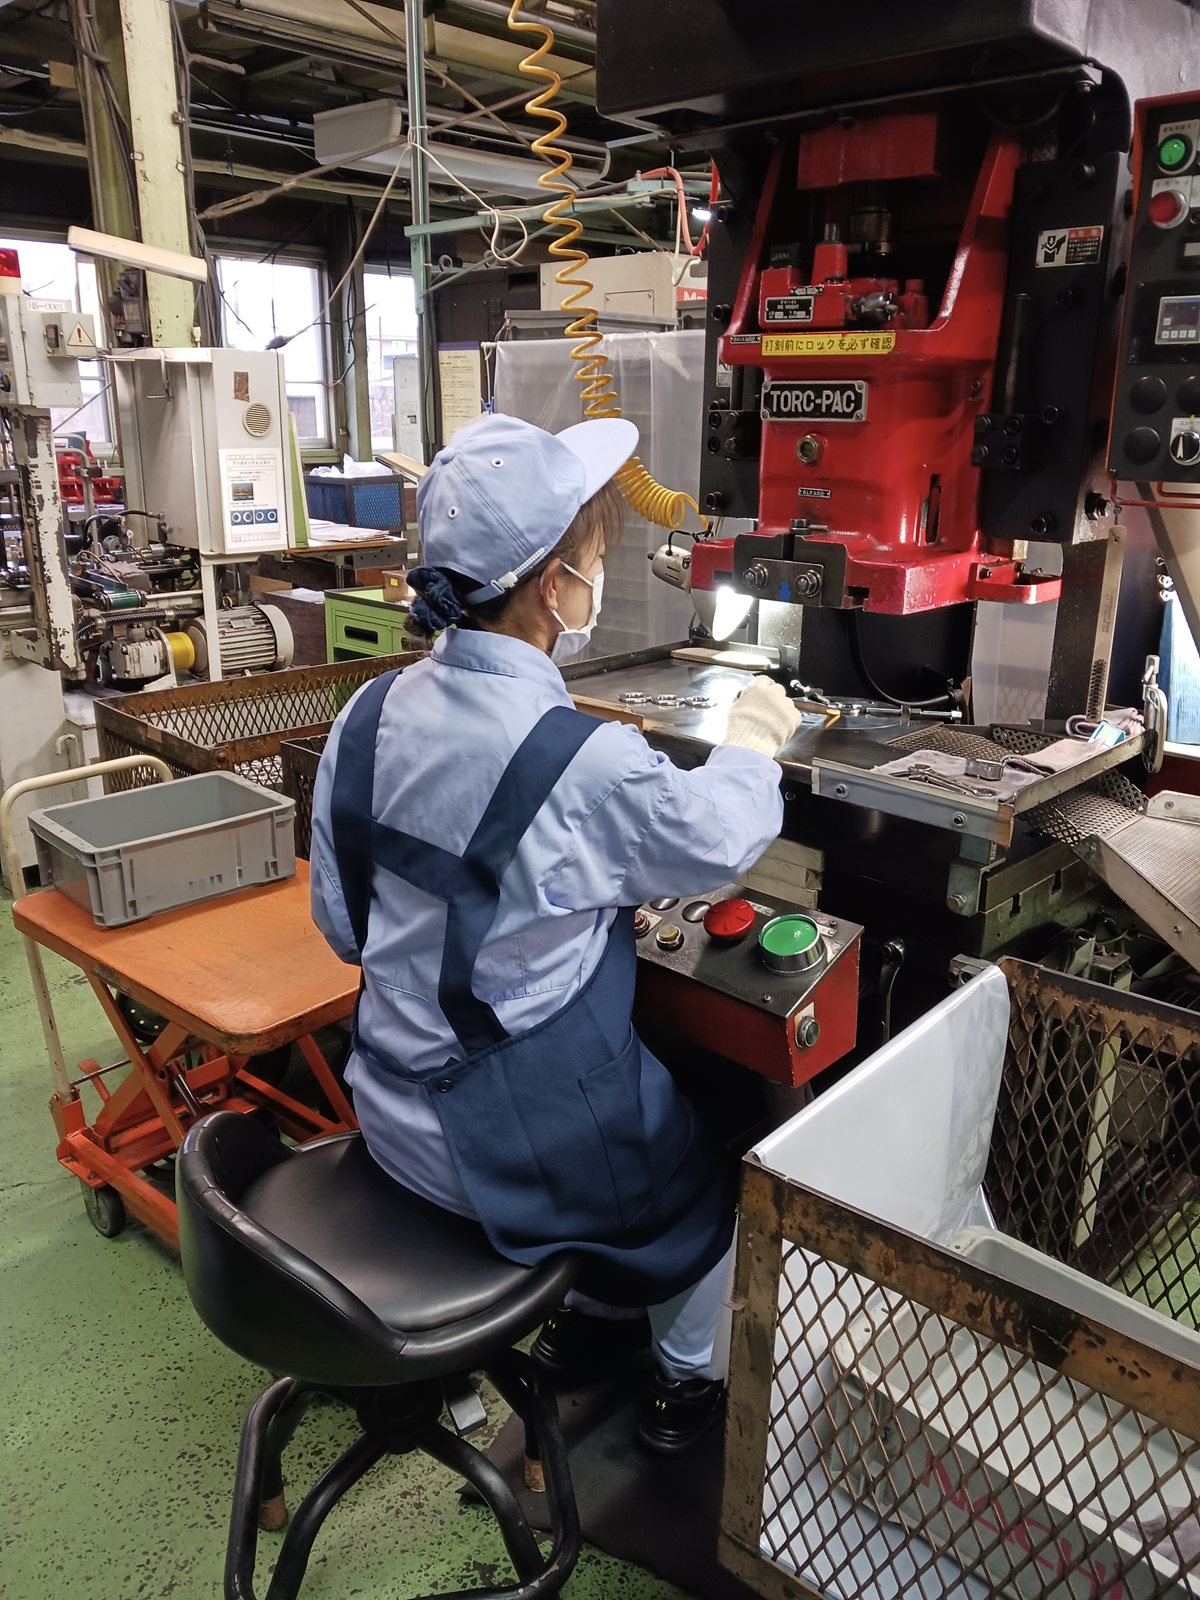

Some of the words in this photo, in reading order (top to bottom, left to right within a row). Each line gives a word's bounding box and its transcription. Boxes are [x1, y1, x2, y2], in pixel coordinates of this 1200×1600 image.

[764, 337, 893, 352] 打刻前にロックを必ず確認
[770, 390, 856, 413] TORC-PAC
